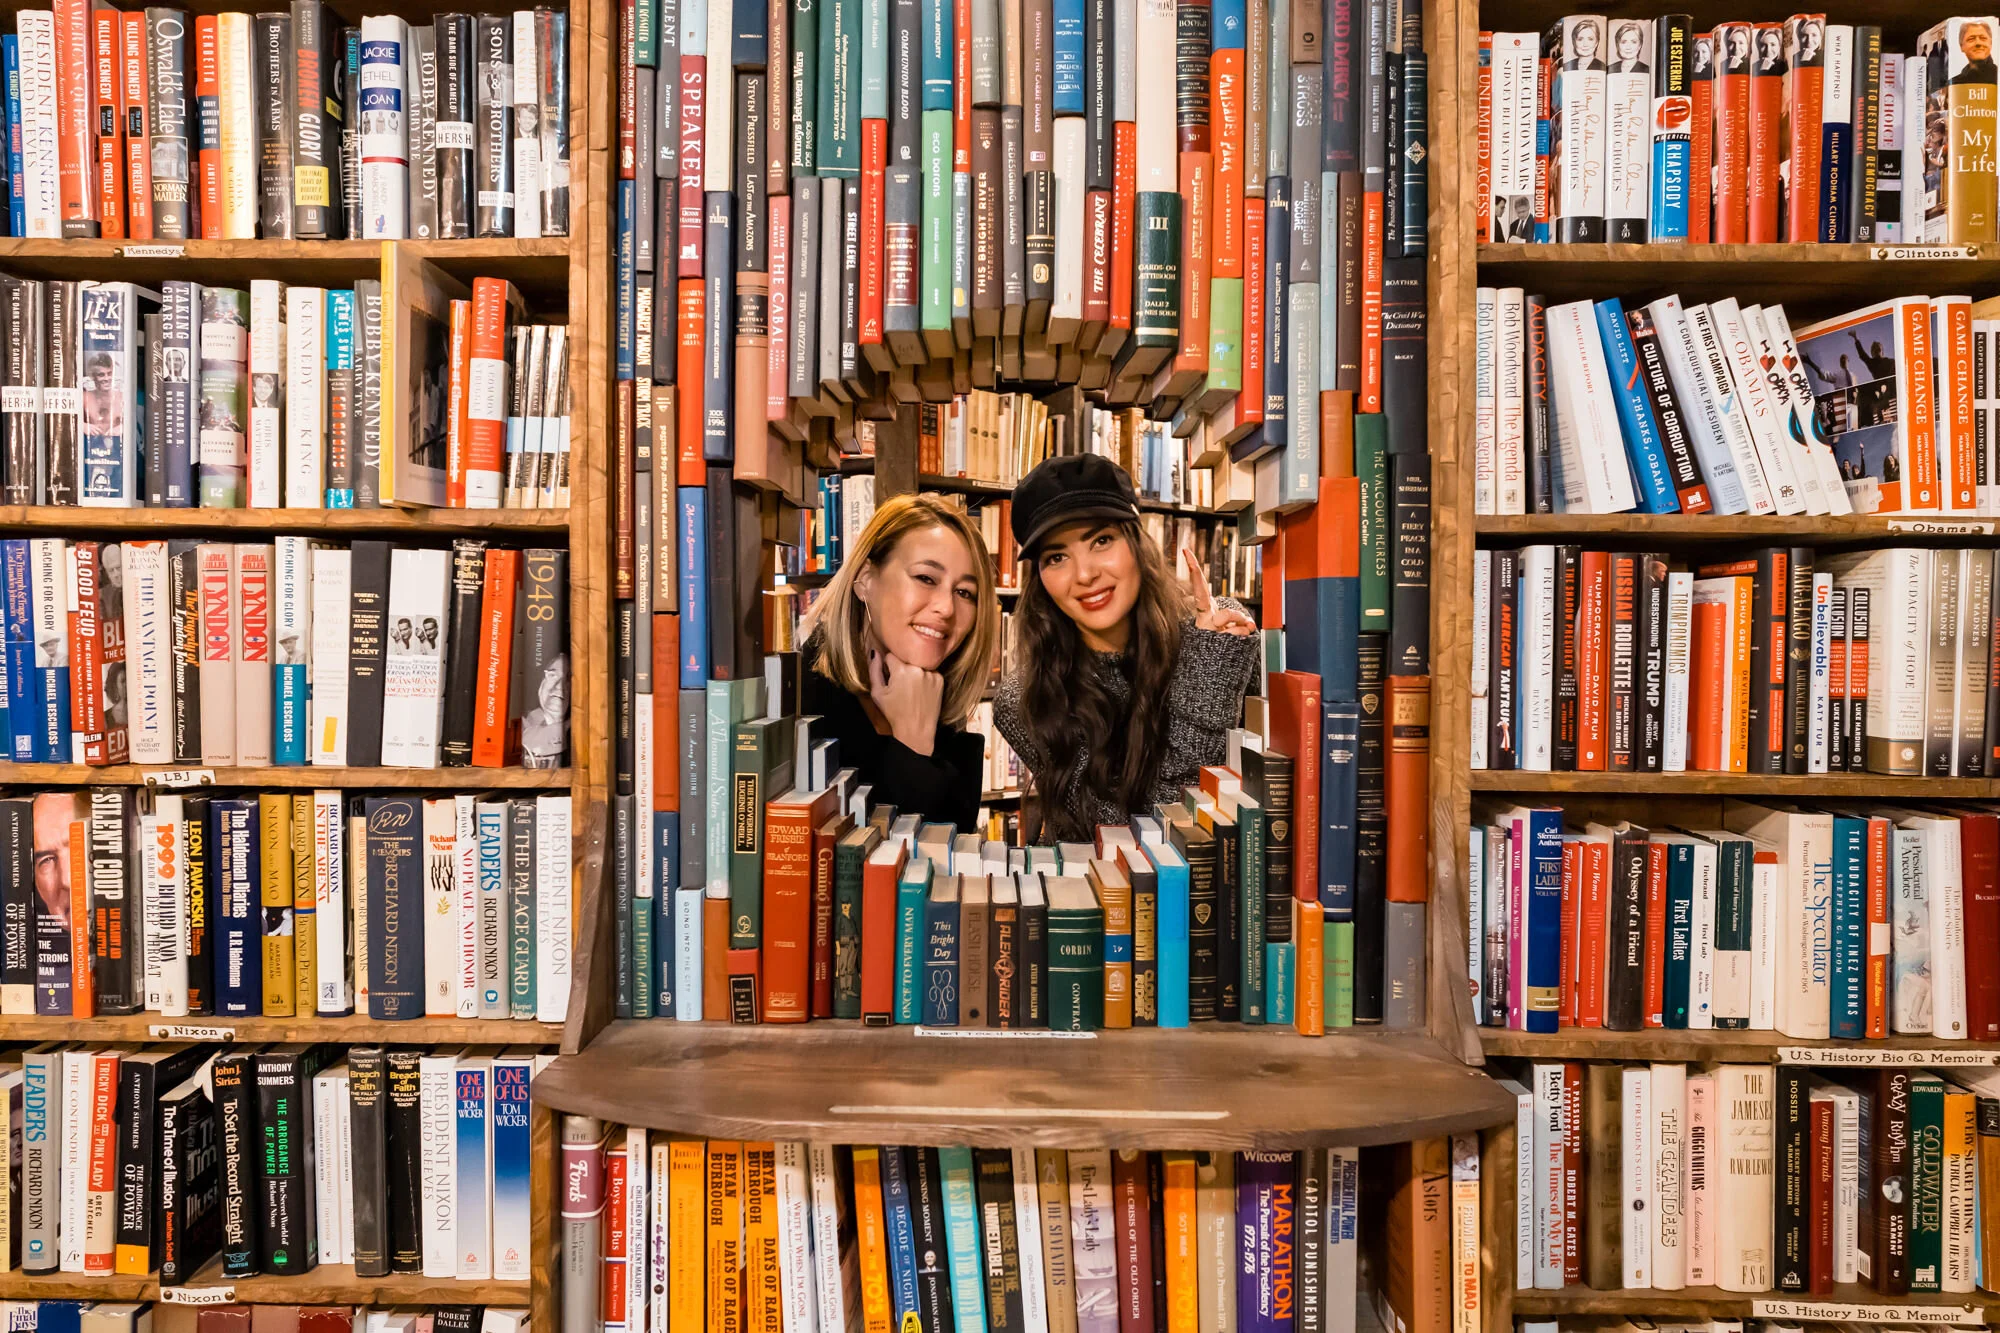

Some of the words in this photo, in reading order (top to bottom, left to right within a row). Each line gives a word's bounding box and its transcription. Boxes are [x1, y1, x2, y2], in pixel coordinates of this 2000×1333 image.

[98, 20, 111, 56] KILLING
[362, 47, 396, 59] JACKIE
[490, 26, 502, 69] SONS
[1671, 27, 1683, 42] JOE
[156, 18, 184, 94] Oswald's
[202, 27, 214, 83] VENDETTA
[269, 25, 280, 83] BROTHERS
[793, 52, 804, 74] Wars
[1670, 45, 1683, 92] ESZTERHAS
[98, 58, 112, 101] KENNEDY
[298, 49, 319, 108] BROKEN
[363, 71, 396, 82] ETHEL
[422, 51, 435, 111] BOBBY
[490, 77, 501, 90] &
[1968, 88, 1987, 101] Bill
[271, 97, 281, 131] ARMS
[364, 94, 394, 105] JOAN
[748, 79, 758, 113] STEVEN
[792, 76, 803, 121] Between
[1953, 106, 1997, 118] Clinton
[159, 97, 186, 134] Tale
[682, 73, 701, 189] SPEAKER
[1478, 74, 1491, 160] UNLIMITED
[102, 143, 112, 161] BILL
[298, 114, 321, 161] GLORY
[438, 132, 472, 145] HERSH
[490, 100, 501, 183] BROTHERS
[747, 115, 758, 164] PRESSFIELD
[792, 124, 803, 167] Journeys
[932, 132, 940, 152] eco
[1831, 132, 1839, 165] HILLARY
[1962, 130, 1992, 151] My
[422, 115, 436, 202] KENNEDY
[933, 156, 941, 197] barons
[1666, 144, 1682, 209] RHAPSODY
[1958, 154, 1995, 172] Life
[103, 162, 114, 194] O'REILLY
[153, 184, 187, 192] NORMAN
[978, 172, 988, 211] RIVER
[1478, 165, 1489, 217] ACCESS
[1829, 167, 1838, 203] RODHAM
[154, 192, 188, 202] MAILER
[977, 215, 987, 265] BRIGHT
[1828, 205, 1836, 241] CLINTON
[127, 246, 181, 256] Kennedys
[772, 252, 785, 285] THE
[1895, 249, 1959, 259] Clintons
[977, 269, 987, 294] THIS
[84, 301, 121, 320] JFK
[162, 286, 173, 340] CHARGE
[175, 287, 189, 340] TAKING
[772, 293, 785, 345] CABAL
[1529, 302, 1547, 400] AUDACITY
[1912, 311, 1925, 356] GAME
[1642, 343, 1666, 392] CULTURE
[1658, 393, 1670, 410] OF
[1914, 361, 1927, 425] CHANGE
[1374, 450, 1384, 468] THE
[1663, 411, 1695, 483] CORRUPTION
[1648, 454, 1666, 495] OBAMA
[1374, 473, 1384, 529] VALCOURT
[1913, 524, 1967, 533] Obama
[77, 549, 94, 596] BLOOD
[1375, 534, 1386, 577] HEIRESS
[1401, 559, 1424, 567] COLD
[527, 554, 555, 621] 1948
[1616, 558, 1633, 621] RUSSIAN
[80, 600, 95, 637] FEUD
[202, 573, 231, 663] LYNDON
[1651, 588, 1660, 647] UNDERSTANDING
[1816, 585, 1829, 677] Unbelievable
[1854, 590, 1867, 638] COLLUSION
[1614, 624, 1633, 689] ROULETTE
[1647, 649, 1661, 708] TRUMP
[164, 772, 190, 782] LBJ
[91, 793, 123, 855] SILENT
[232, 809, 250, 831] The
[768, 825, 809, 835] EDWARD
[156, 823, 176, 879] 1999
[479, 813, 501, 892] LEADERS
[514, 830, 529, 868] THE
[770, 834, 806, 844] FRISBIE
[232, 833, 250, 887] Haldeman
[817, 848, 833, 897] Coming
[1814, 857, 1832, 892] The
[93, 859, 123, 900] COUP
[1627, 857, 1642, 902] Odyssey
[232, 889, 250, 918] Diaries
[514, 872, 529, 936] PALACE
[1630, 905, 1640, 917] of
[1674, 899, 1689, 925] First
[816, 899, 829, 948] Home
[930, 934, 954, 945] Bright
[934, 921, 951, 931] This
[1805, 896, 1832, 987] Speculator
[933, 947, 952, 959] Day
[1060, 944, 1092, 955] CORBIN
[1628, 932, 1640, 967] Friend
[1673, 927, 1689, 961] Ladies
[514, 938, 529, 995] GUARD
[173, 1027, 218, 1036] Nixon
[258, 1063, 292, 1073] ANTHONY
[497, 1068, 525, 1084] ONE
[1790, 1051, 1815, 1061] U.S.
[1821, 1052, 1876, 1064] History
[1882, 1054, 1904, 1063] Bio
[1908, 1053, 1925, 1063] &
[1930, 1054, 1985, 1063] Memoir
[258, 1076, 294, 1085] SUMMERS
[494, 1085, 510, 1101] OF
[511, 1085, 528, 1101] US
[1549, 1071, 1562, 1103] Betty
[26, 1064, 46, 1143] LEADERS
[495, 1115, 528, 1127] WICKER
[501, 1103, 521, 1114] TOM
[1549, 1106, 1561, 1132] Ford
[1661, 1109, 1678, 1145] THE
[29, 1148, 43, 1196] RICHARD
[569, 1160, 588, 1202] Fords
[711, 1153, 723, 1226] BURROUGH
[724, 1153, 737, 1198] BRYAN
[1922, 1124, 1941, 1234] GOLDWATER
[29, 1197, 43, 1230] NIXON
[1305, 1178, 1318, 1235] CAPITOL
[1661, 1150, 1678, 1248] GRANDEES
[724, 1240, 736, 1274] DAYS
[1273, 1184, 1293, 1320] MARATHON
[178, 1292, 221, 1303] Nixon
[724, 1279, 736, 1294] OF
[1305, 1242, 1318, 1332] PUNISHMENT
[437, 1319, 470, 1328] DALLEK
[438, 1311, 471, 1321] ROBERT
[1765, 1304, 1790, 1314] U.S.
[1796, 1306, 1851, 1318] History
[1857, 1309, 1880, 1319] Bio
[1884, 1309, 1901, 1319] &
[1907, 1311, 1961, 1322] Memoir
